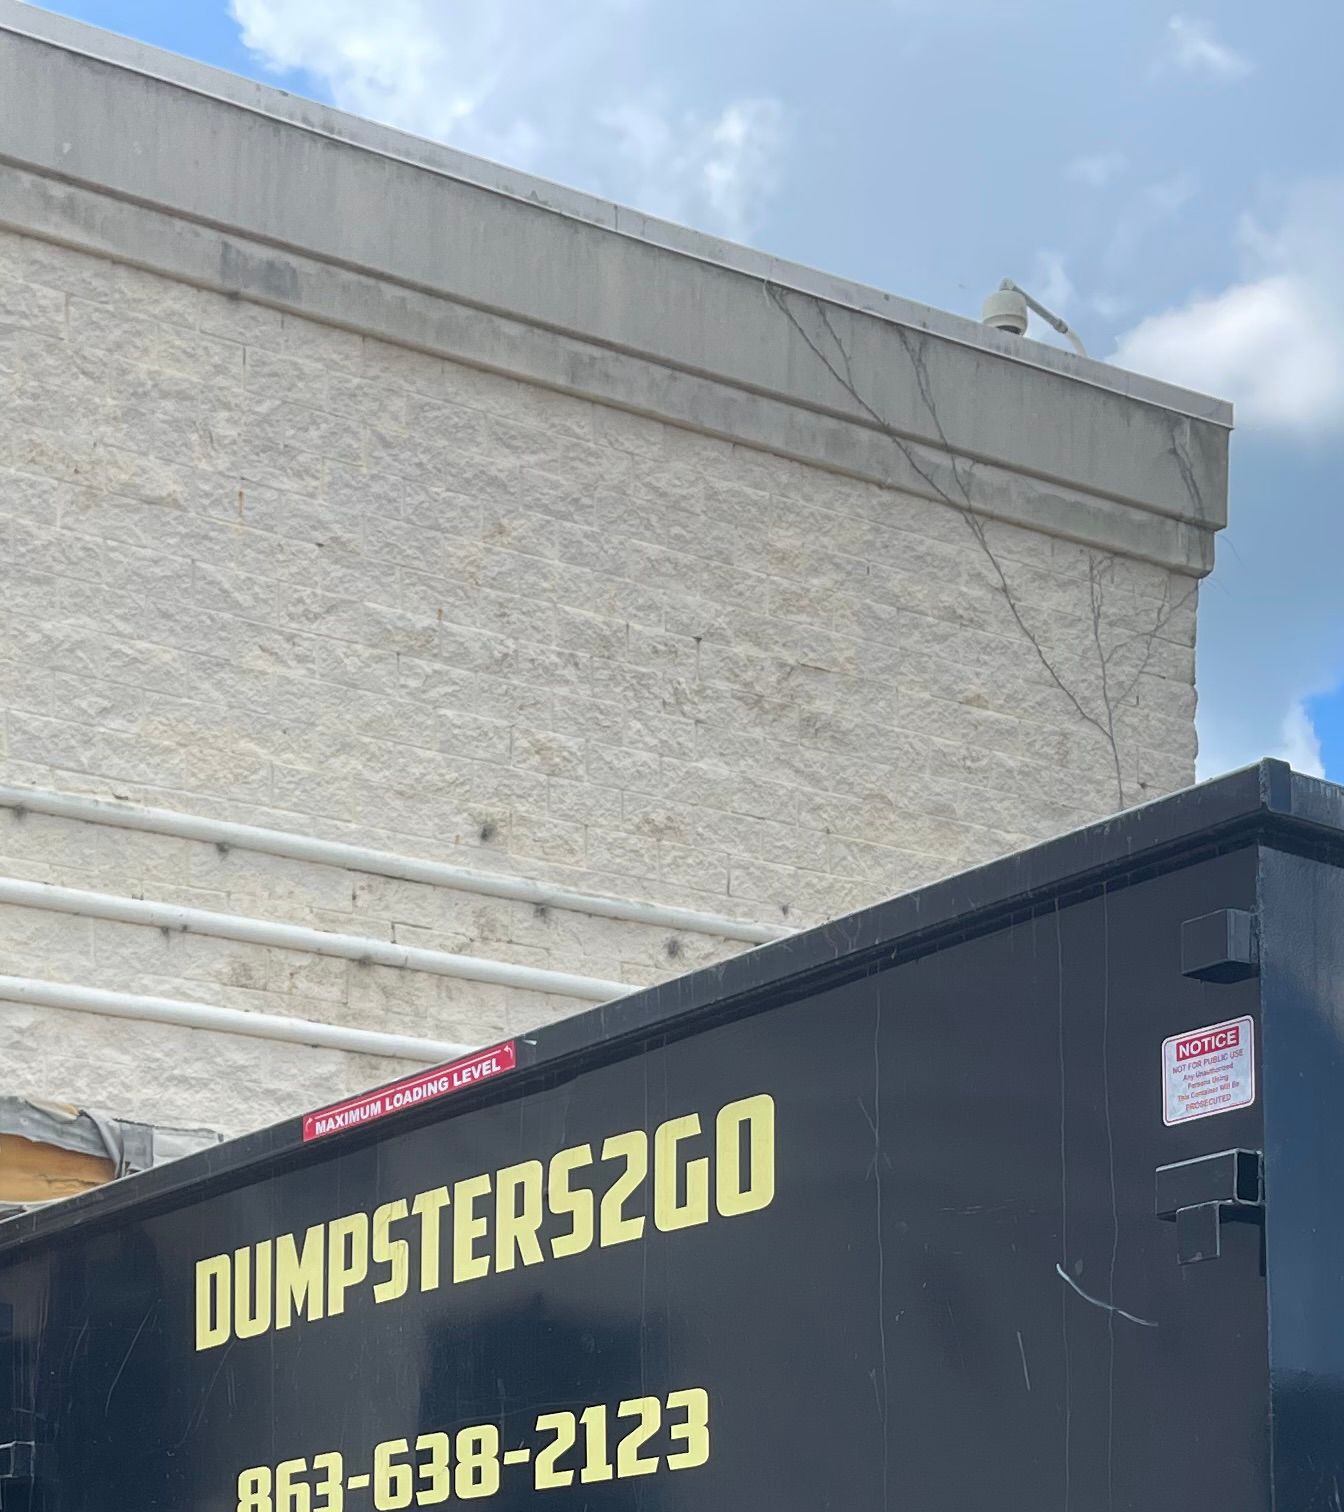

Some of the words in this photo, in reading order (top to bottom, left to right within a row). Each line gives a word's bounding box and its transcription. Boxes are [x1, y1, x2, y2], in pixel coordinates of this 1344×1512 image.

[1178, 1029, 1237, 1059] NOTICE
[1172, 1063, 1187, 1074] NOT
[1187, 1059, 1202, 1071] FOR
[1203, 1053, 1229, 1066] PUBLIC
[1229, 1048, 1244, 1059] USE
[1183, 1073, 1195, 1081] Any
[1187, 1079, 1210, 1090] Persons
[1212, 1074, 1229, 1084] Using
[315, 1100, 382, 1135] MAXIMUM
[385, 1076, 449, 1110] LOADING
[453, 1057, 501, 1087] LEVEL
[1185, 1093, 1232, 1111] PROSECUTED
[195, 1093, 775, 1351] DUMPSTERS2GO
